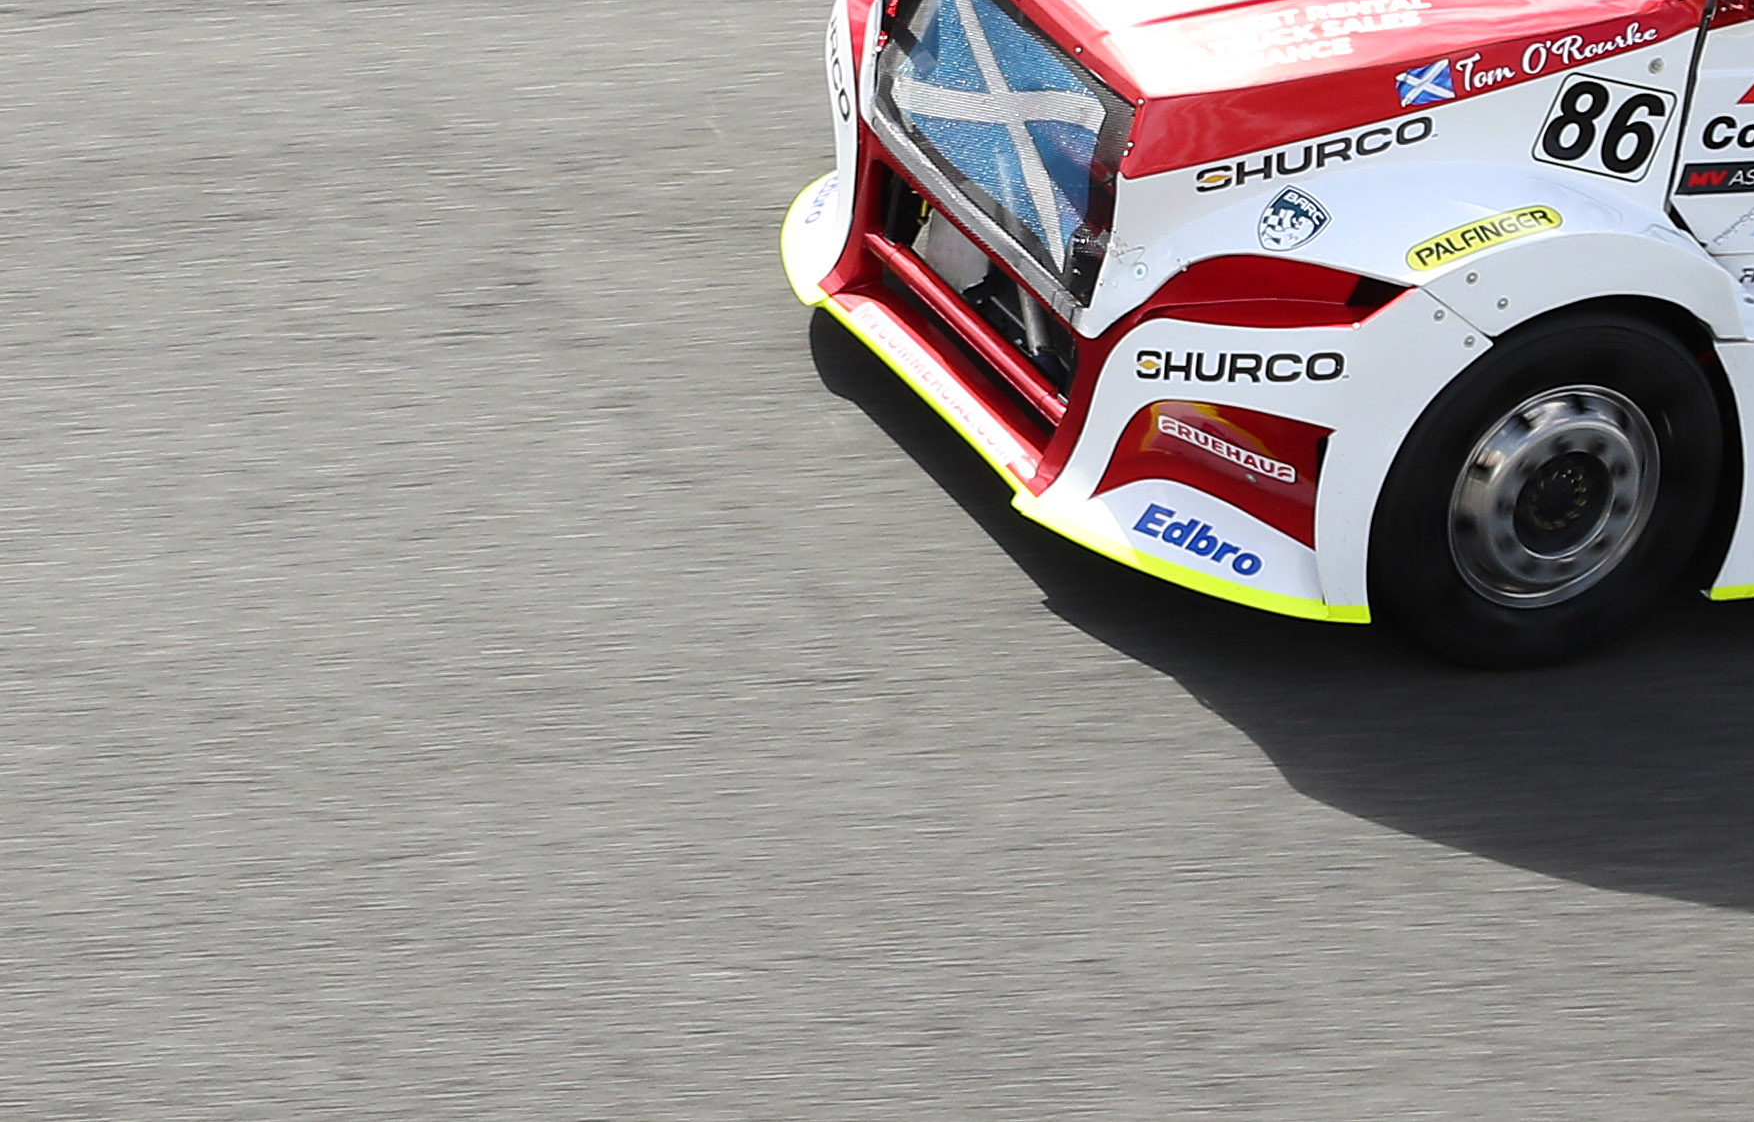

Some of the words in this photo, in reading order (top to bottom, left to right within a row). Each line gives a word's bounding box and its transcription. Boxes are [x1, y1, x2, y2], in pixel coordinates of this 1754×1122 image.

[1321, 11, 1422, 38] SALES
[1455, 52, 1517, 92] Tom
[1521, 22, 1659, 75] O'Rourke
[1195, 115, 1434, 193] SHURCO
[1541, 80, 1667, 175] 86
[1284, 191, 1325, 226] BARC
[1687, 169, 1728, 189] MV
[1413, 208, 1555, 268] PALFINGER
[1135, 349, 1346, 383] SHURCO
[1159, 418, 1295, 481] FRUEHAUF
[1132, 503, 1262, 577] Edbro
